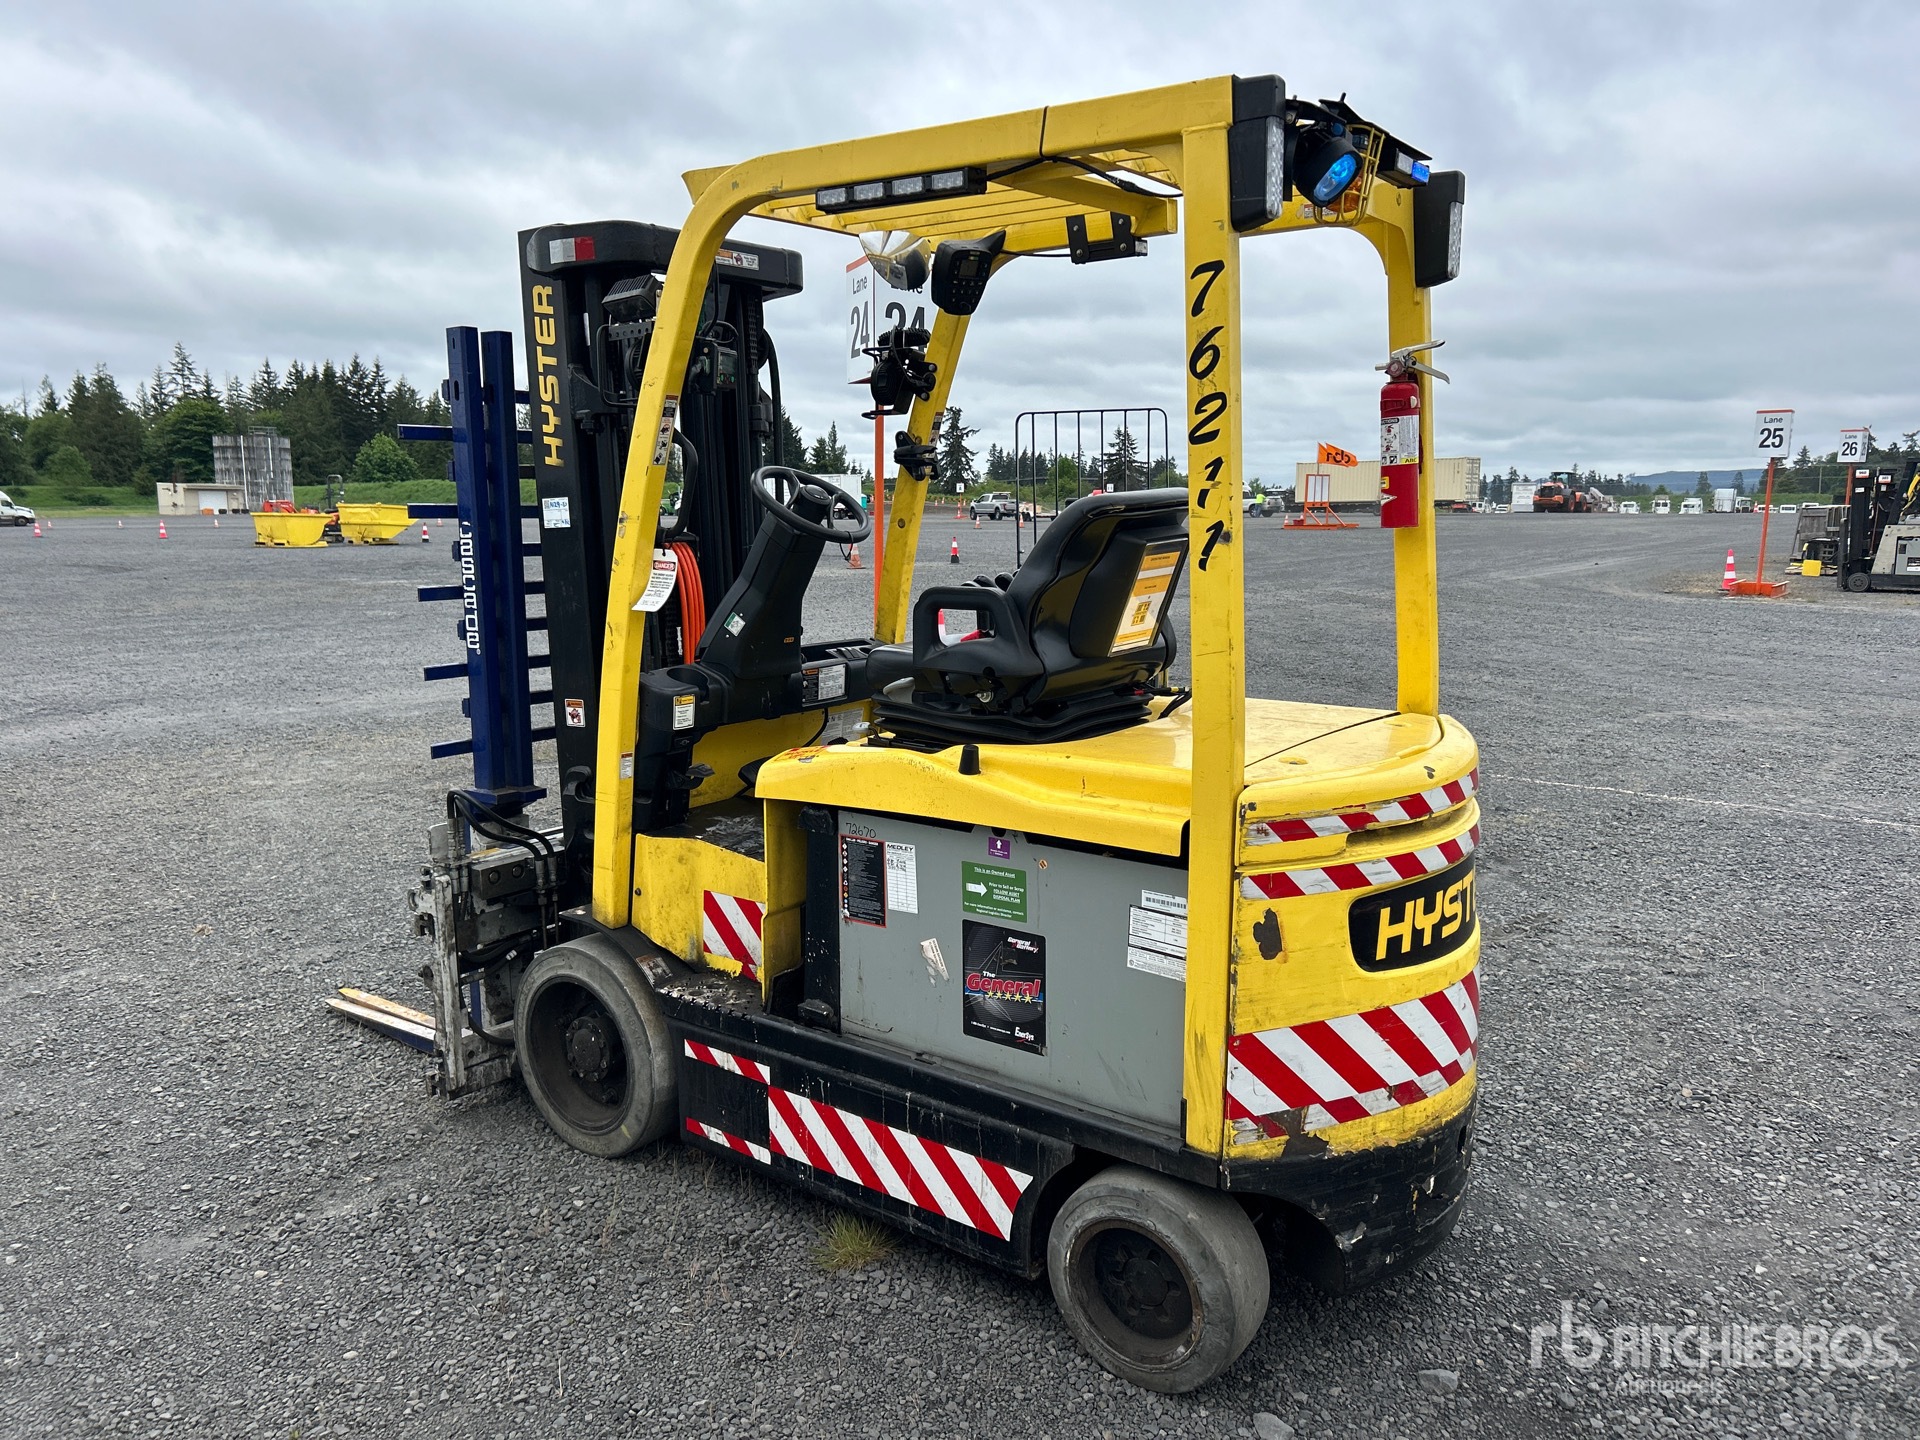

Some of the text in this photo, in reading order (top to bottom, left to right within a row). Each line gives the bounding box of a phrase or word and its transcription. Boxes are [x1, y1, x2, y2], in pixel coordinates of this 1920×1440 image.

[852, 275, 868, 295] Lane
[850, 300, 870, 359] 24
[532, 284, 564, 467] HYSTER
[1188, 259, 1227, 572] 76211
[1763, 416, 1784, 424] Lane
[1758, 427, 1785, 449] 25
[1841, 441, 1858, 456] 26
[654, 561, 675, 570] DANGER
[845, 822, 877, 838] 72670
[886, 843, 914, 852] MEDLEY
[1375, 868, 1476, 961] HYST
[1007, 936, 1031, 946] General
[1016, 943, 1039, 954] Battery
[966, 972, 1041, 997] General
